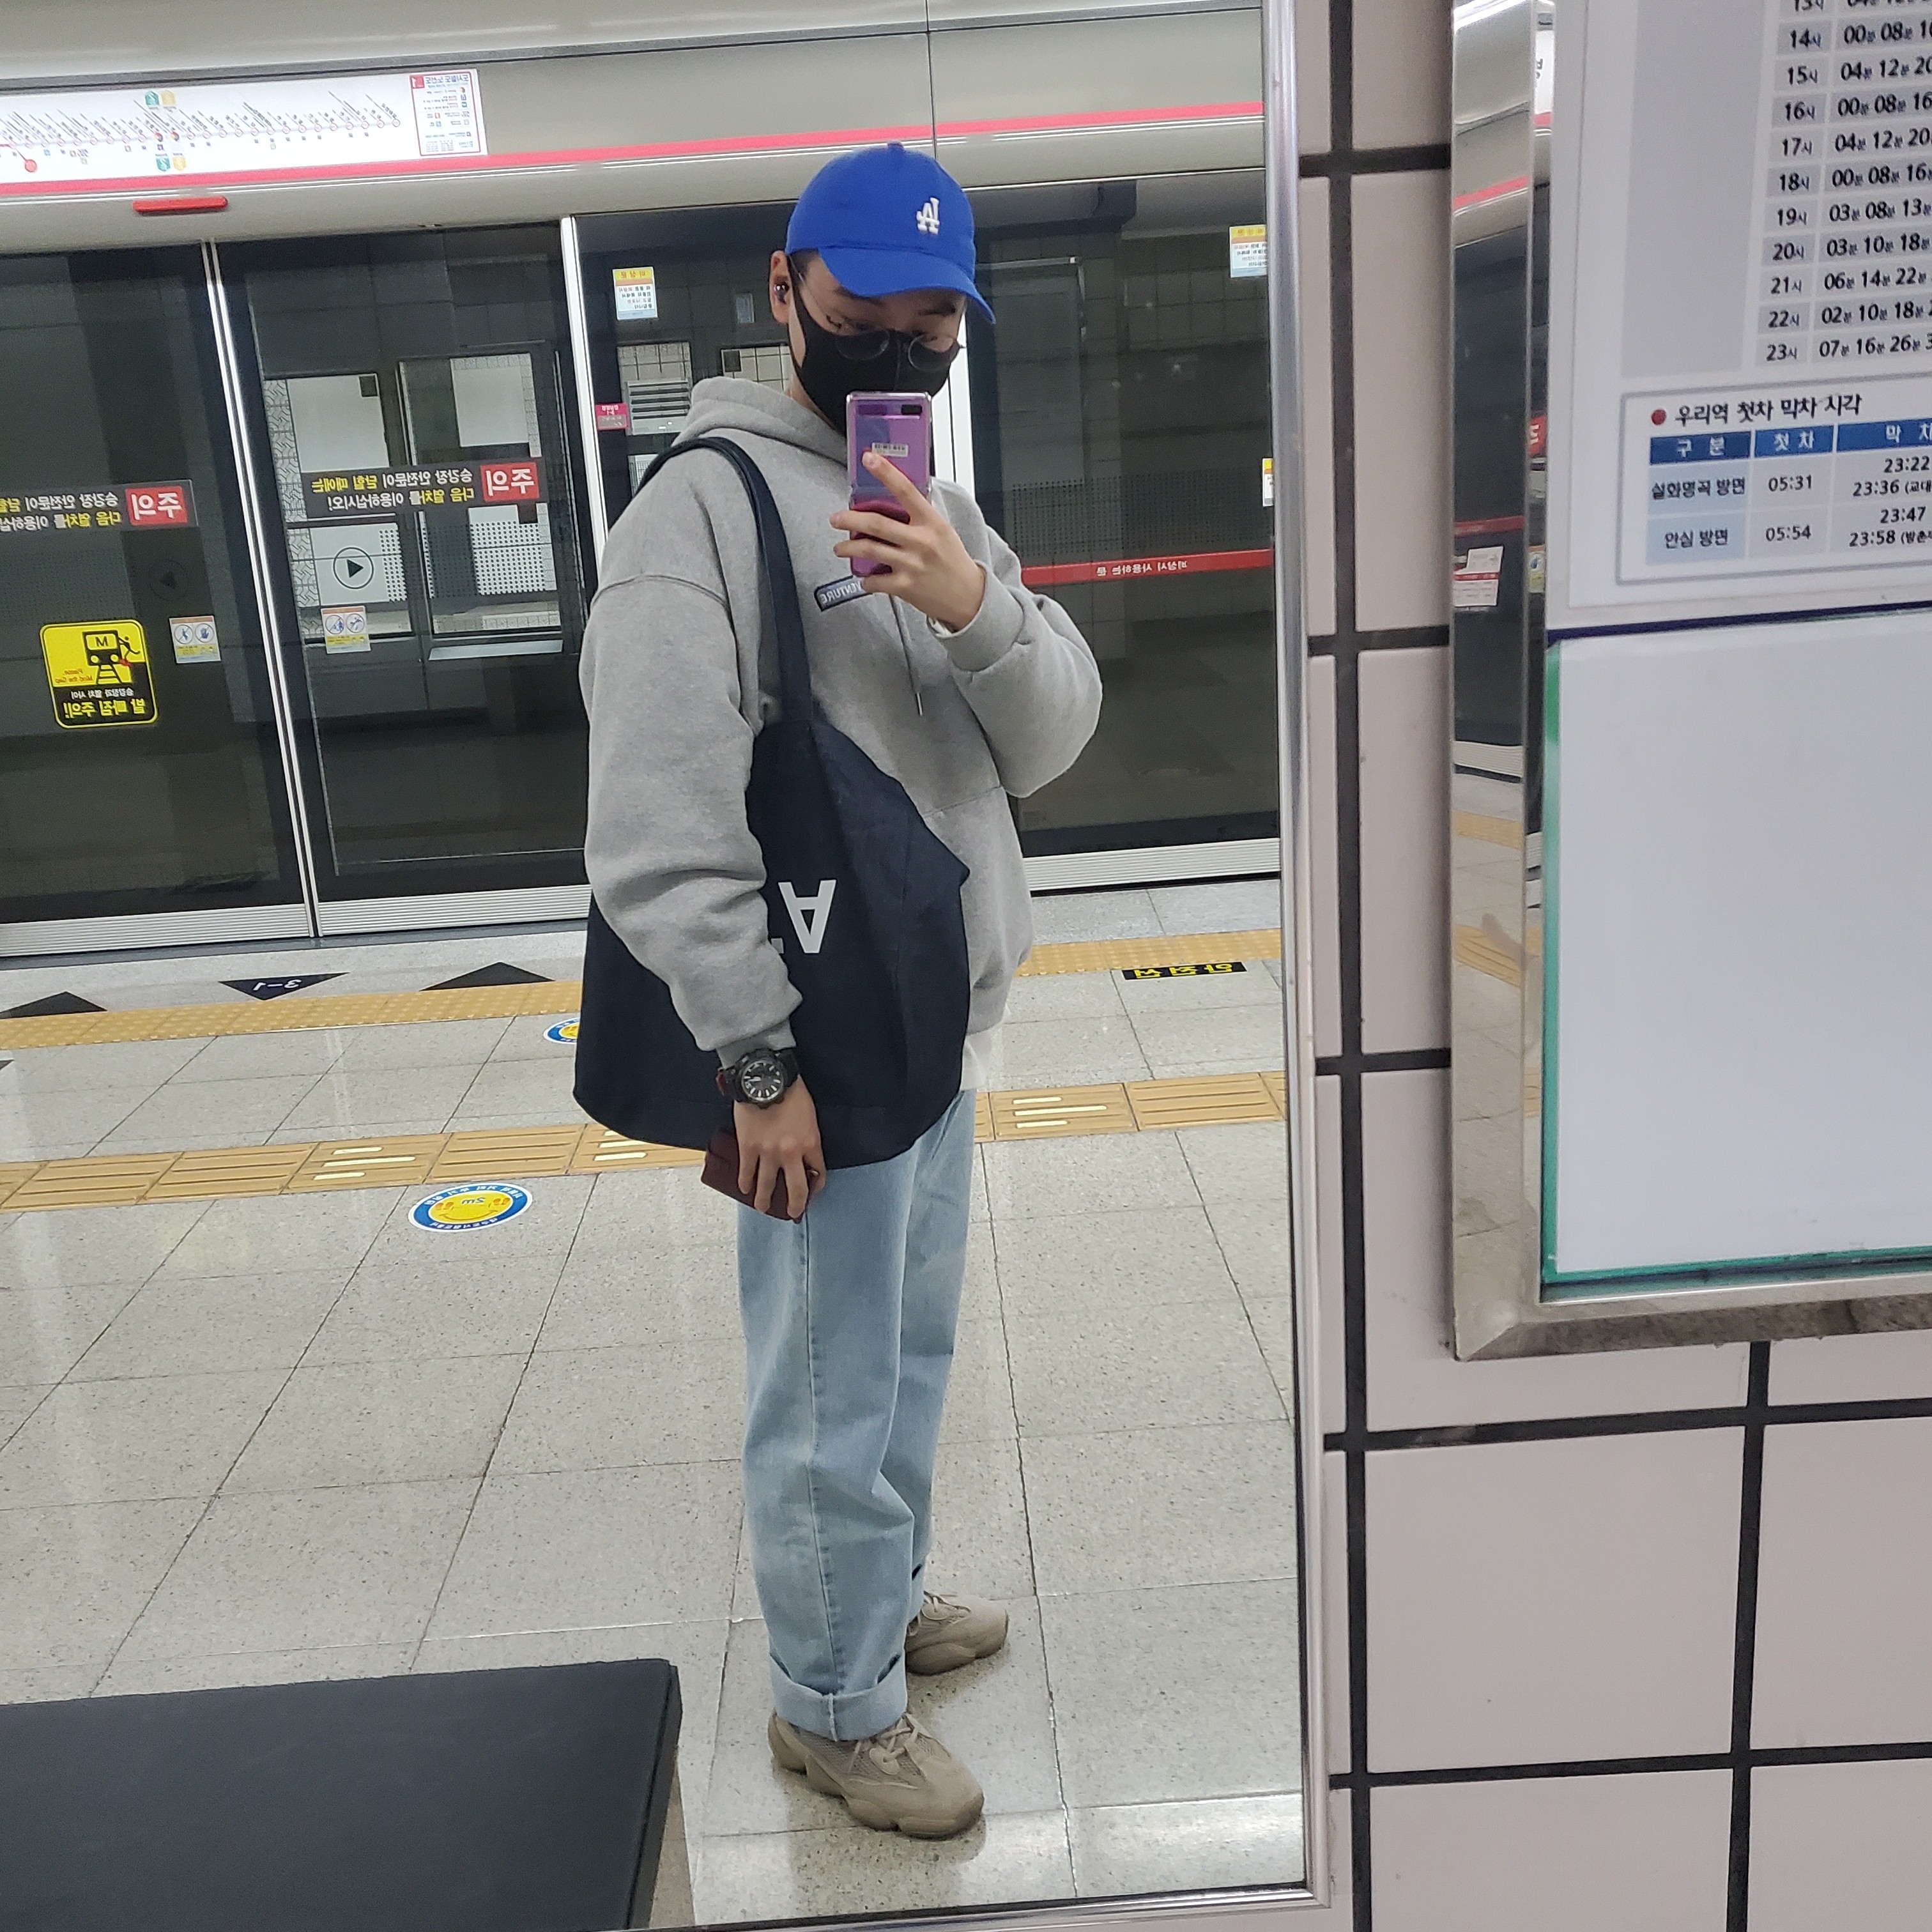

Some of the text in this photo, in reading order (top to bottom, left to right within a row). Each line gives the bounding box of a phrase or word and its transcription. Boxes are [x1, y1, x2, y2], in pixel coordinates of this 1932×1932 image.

[1675, 394, 1862, 427] 우리역 첫차 막차 시각
[1883, 456, 1930, 473] 23:22
[1716, 477, 1745, 496] 방면
[1768, 474, 1812, 492] 05:31
[1853, 479, 1900, 496] 23:36
[1880, 506, 1926, 524] 23:47
[1664, 528, 1728, 549] 안심 방면
[1765, 525, 1812, 541] 05:54
[1849, 530, 1896, 547] 23:58
